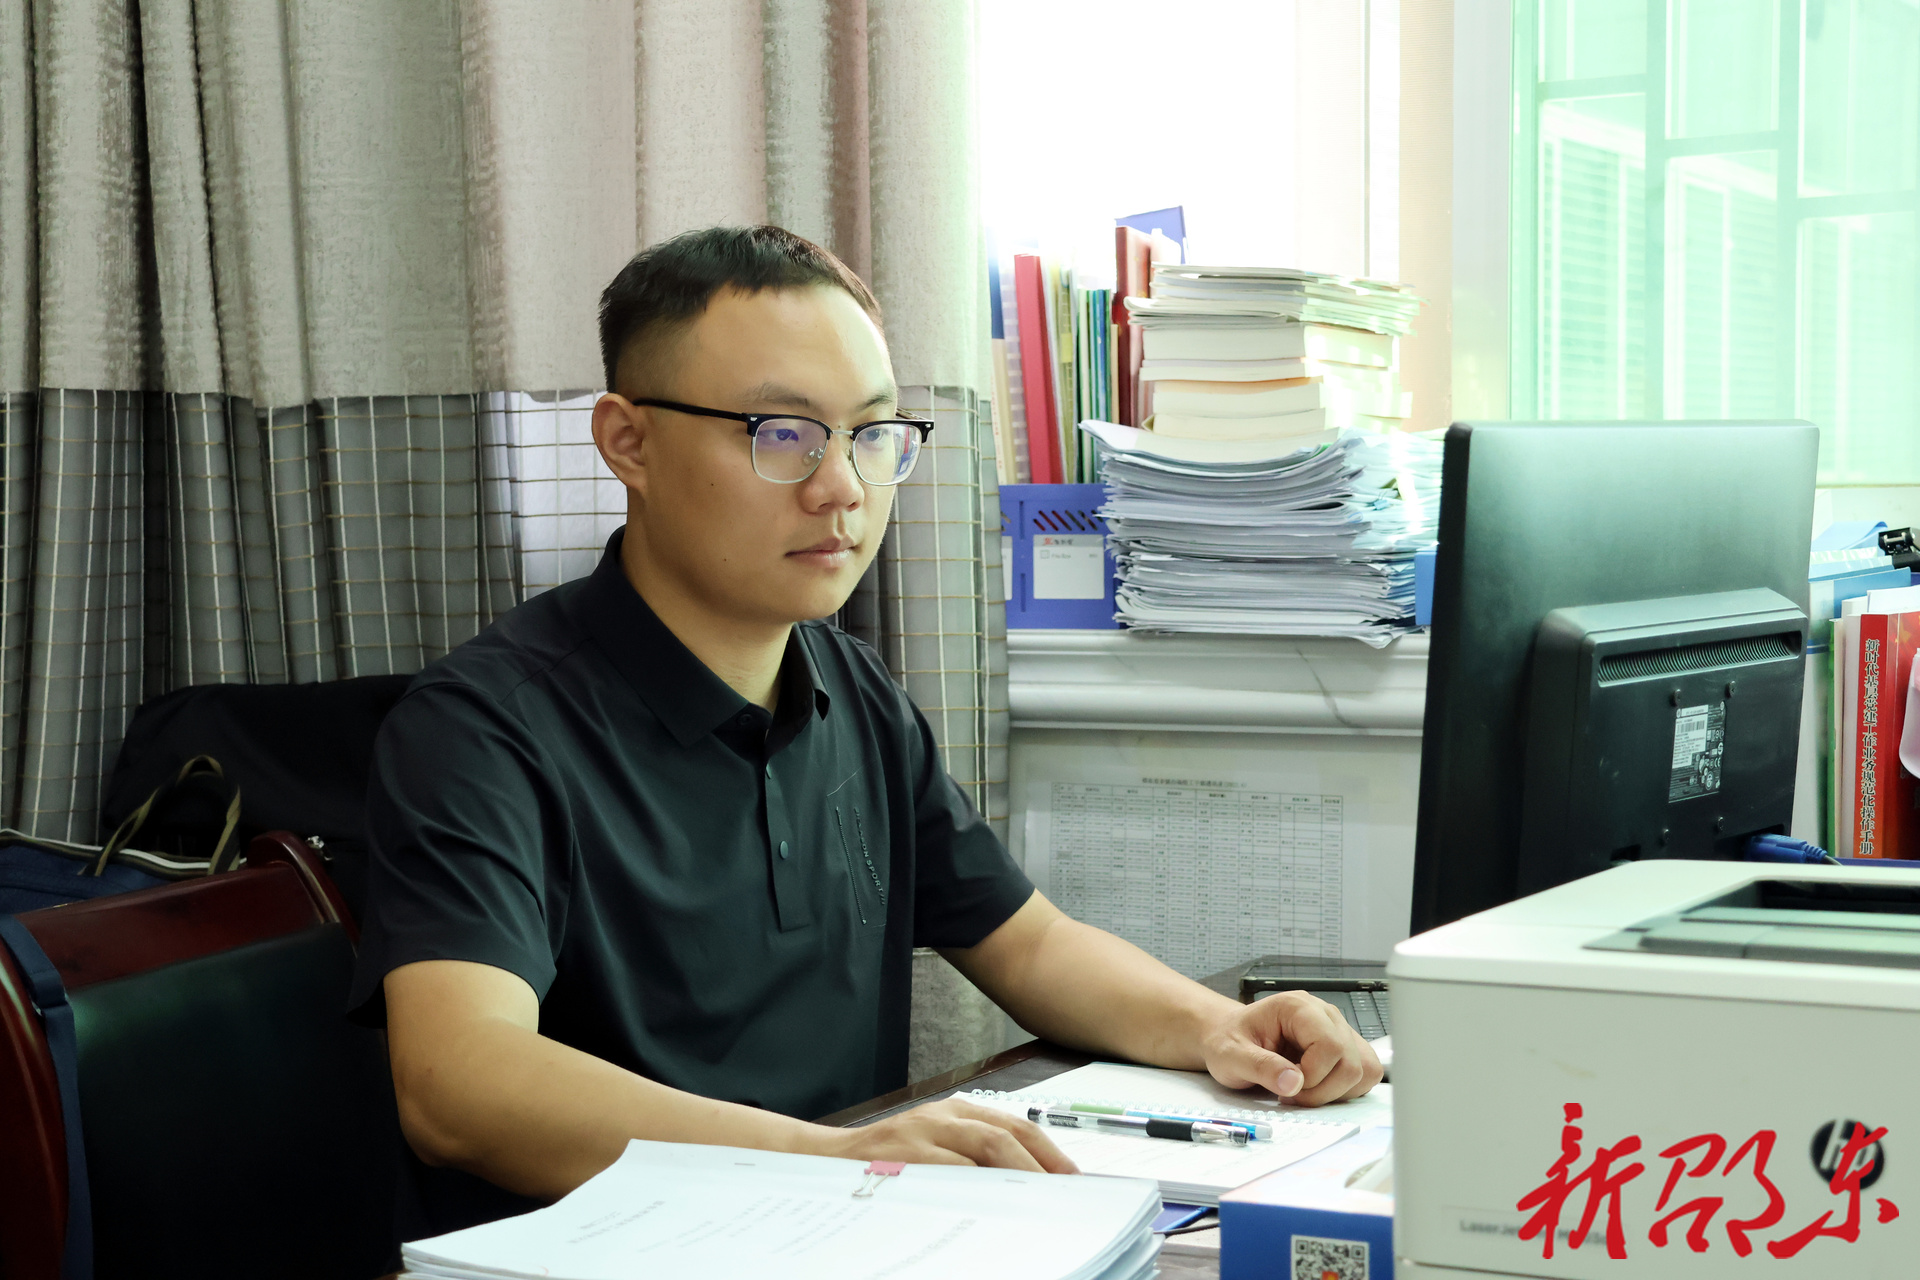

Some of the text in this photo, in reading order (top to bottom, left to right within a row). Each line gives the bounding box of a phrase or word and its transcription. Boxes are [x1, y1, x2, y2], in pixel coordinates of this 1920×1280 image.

[1859, 639, 1880, 855] 新时代基层党建工作业务规范化操作手册
